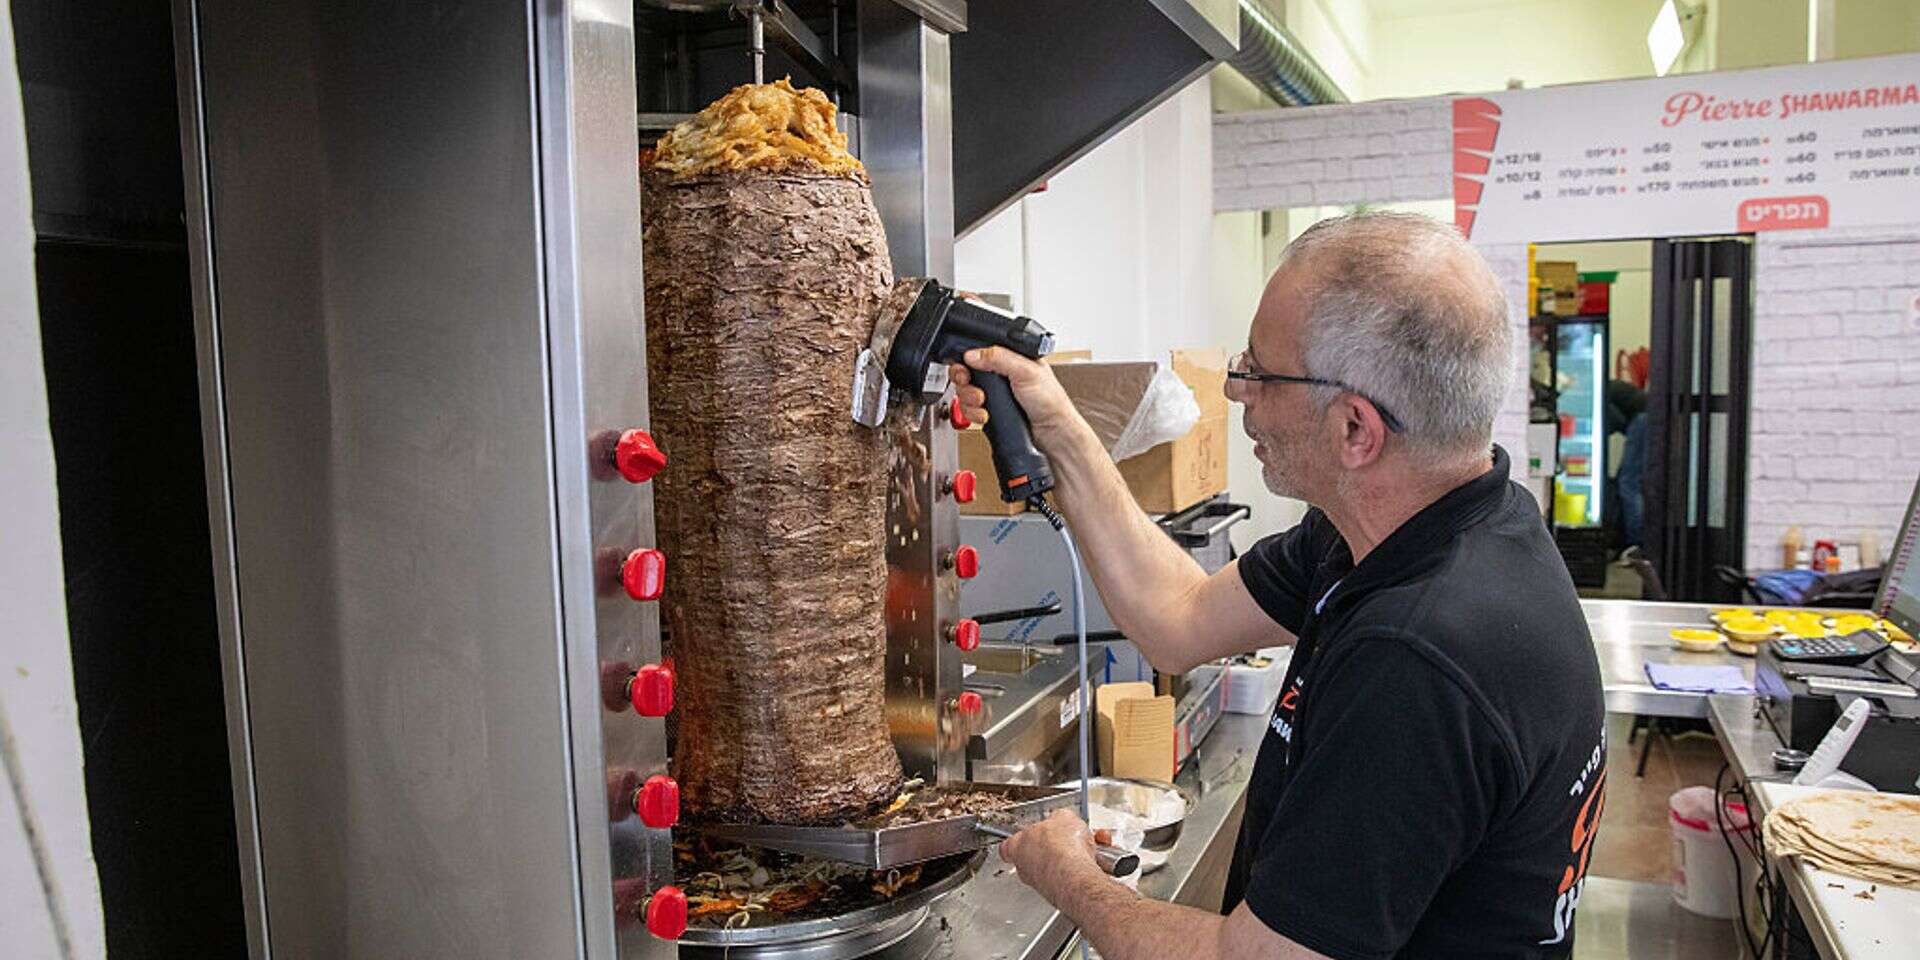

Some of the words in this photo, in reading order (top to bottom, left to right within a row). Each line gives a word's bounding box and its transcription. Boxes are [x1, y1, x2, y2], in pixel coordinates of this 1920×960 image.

[1660, 91, 1773, 127] Pierre
[1779, 84, 1920, 119] SHAWARMA
[1745, 202, 1820, 222] תפריט
